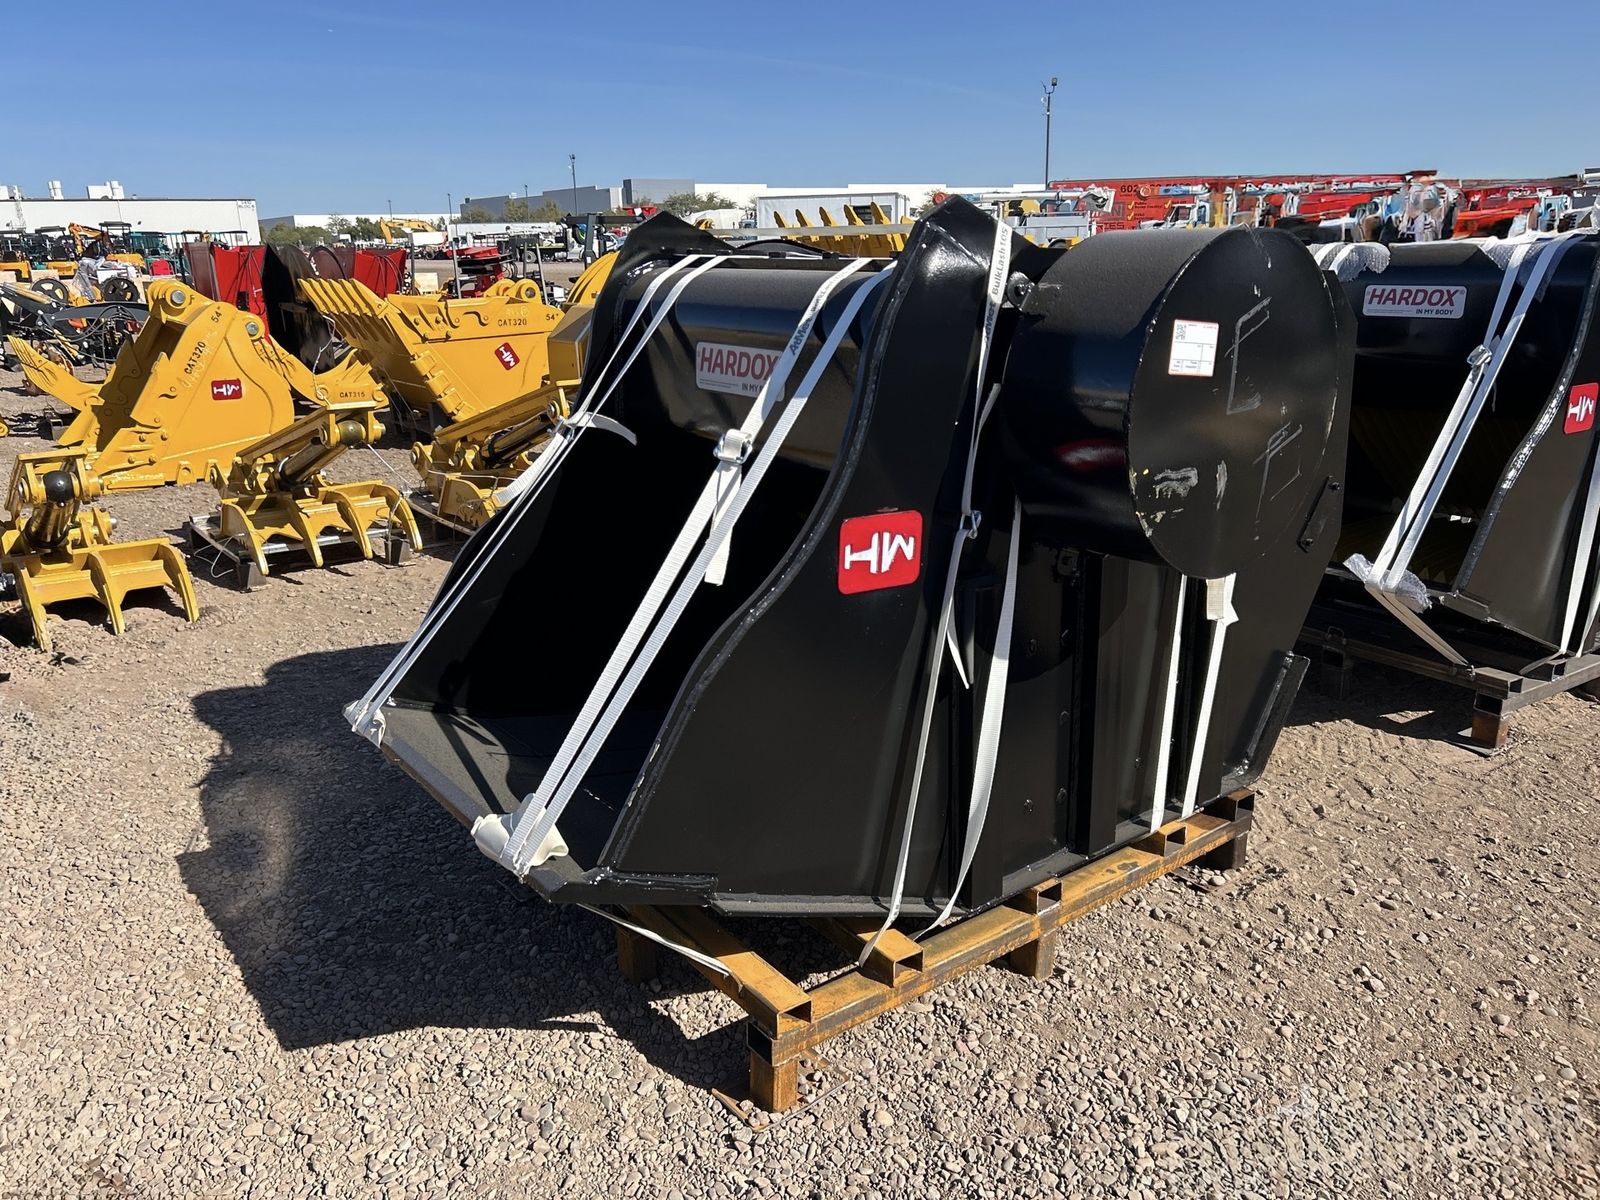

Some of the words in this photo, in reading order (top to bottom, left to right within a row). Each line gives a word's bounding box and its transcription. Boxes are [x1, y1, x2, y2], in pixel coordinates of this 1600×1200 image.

[1435, 308, 1454, 316] BODY
[498, 318, 527, 327] CAT320
[183, 341, 206, 375] CAT320
[700, 346, 780, 381] HARDOX
[741, 382, 748, 391] IN
[748, 383, 760, 393] MY
